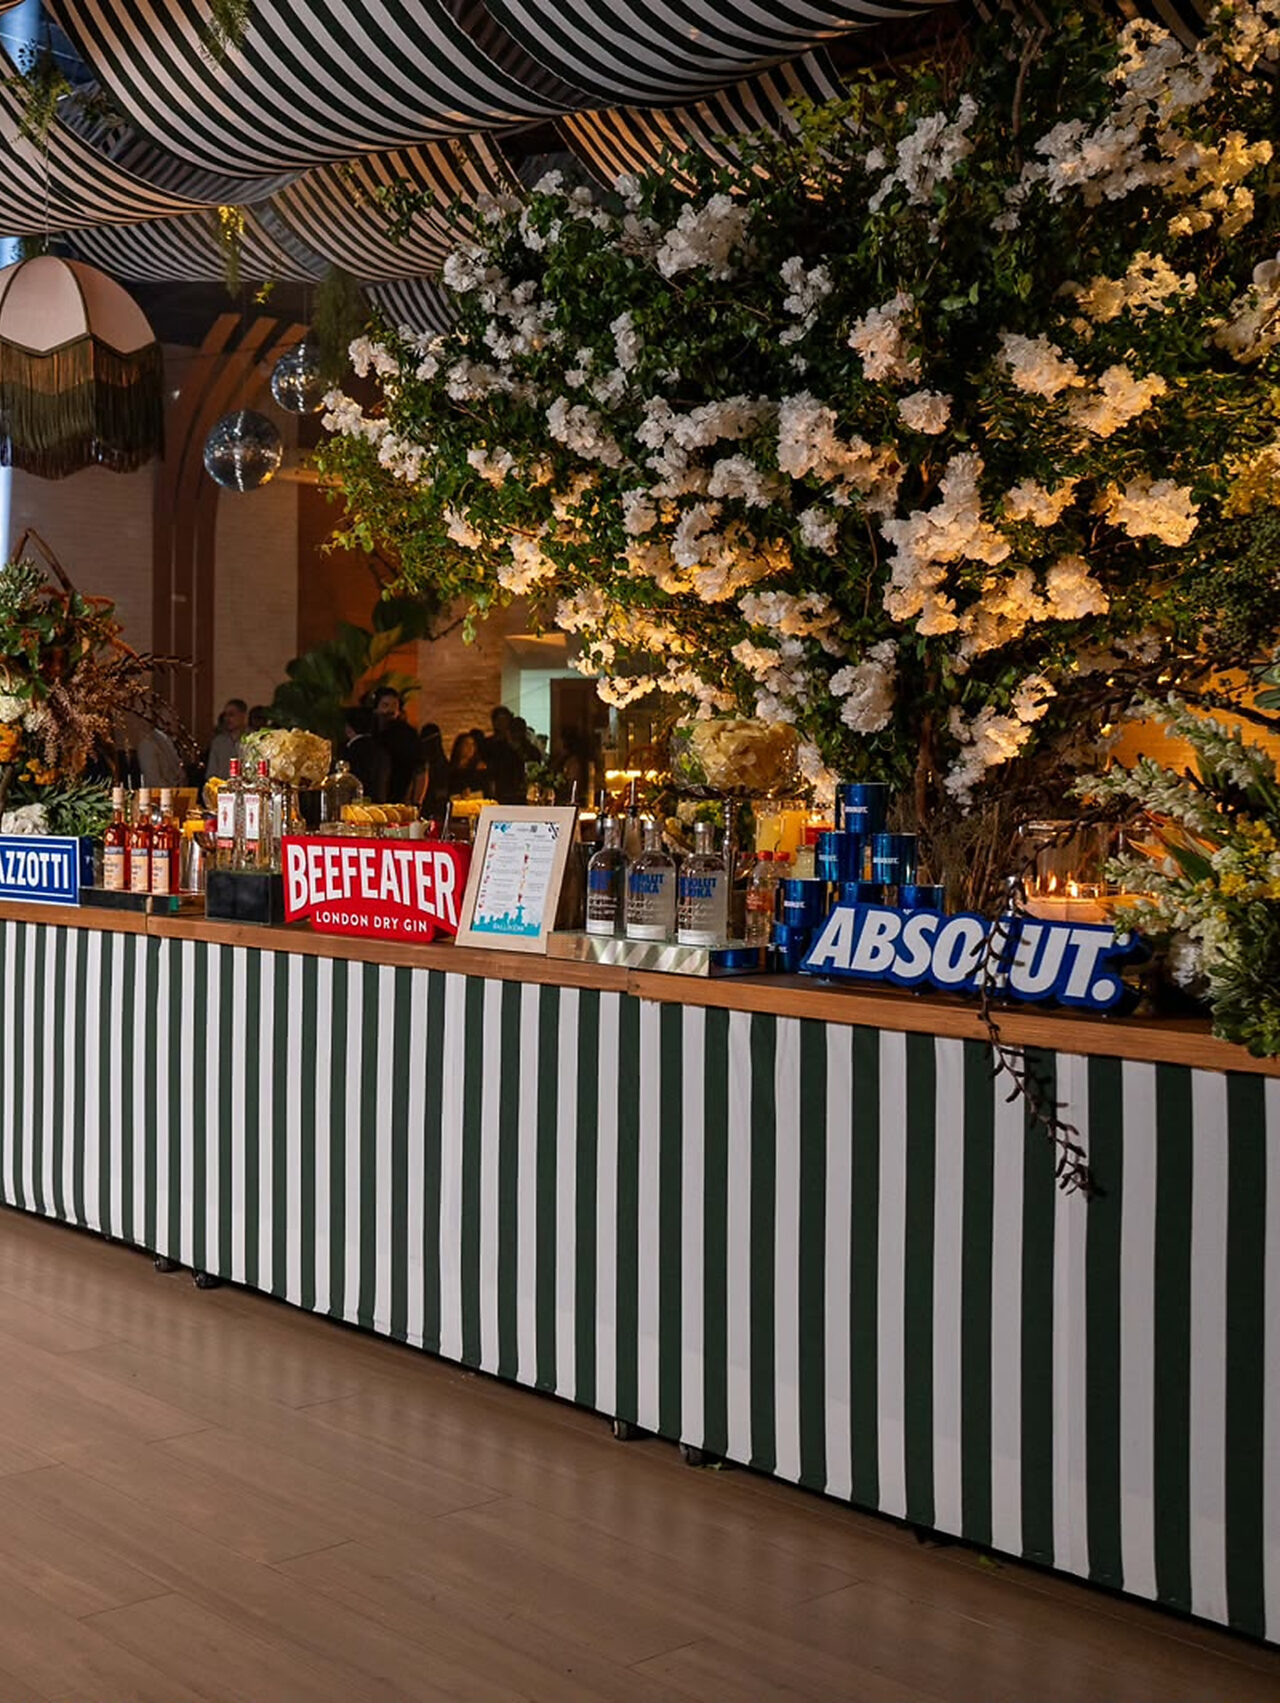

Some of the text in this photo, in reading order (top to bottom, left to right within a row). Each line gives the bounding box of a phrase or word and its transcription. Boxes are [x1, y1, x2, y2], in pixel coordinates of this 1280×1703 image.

[287, 844, 458, 927] BEEFEATER
[316, 910, 428, 933] LONDON DRY GIN
